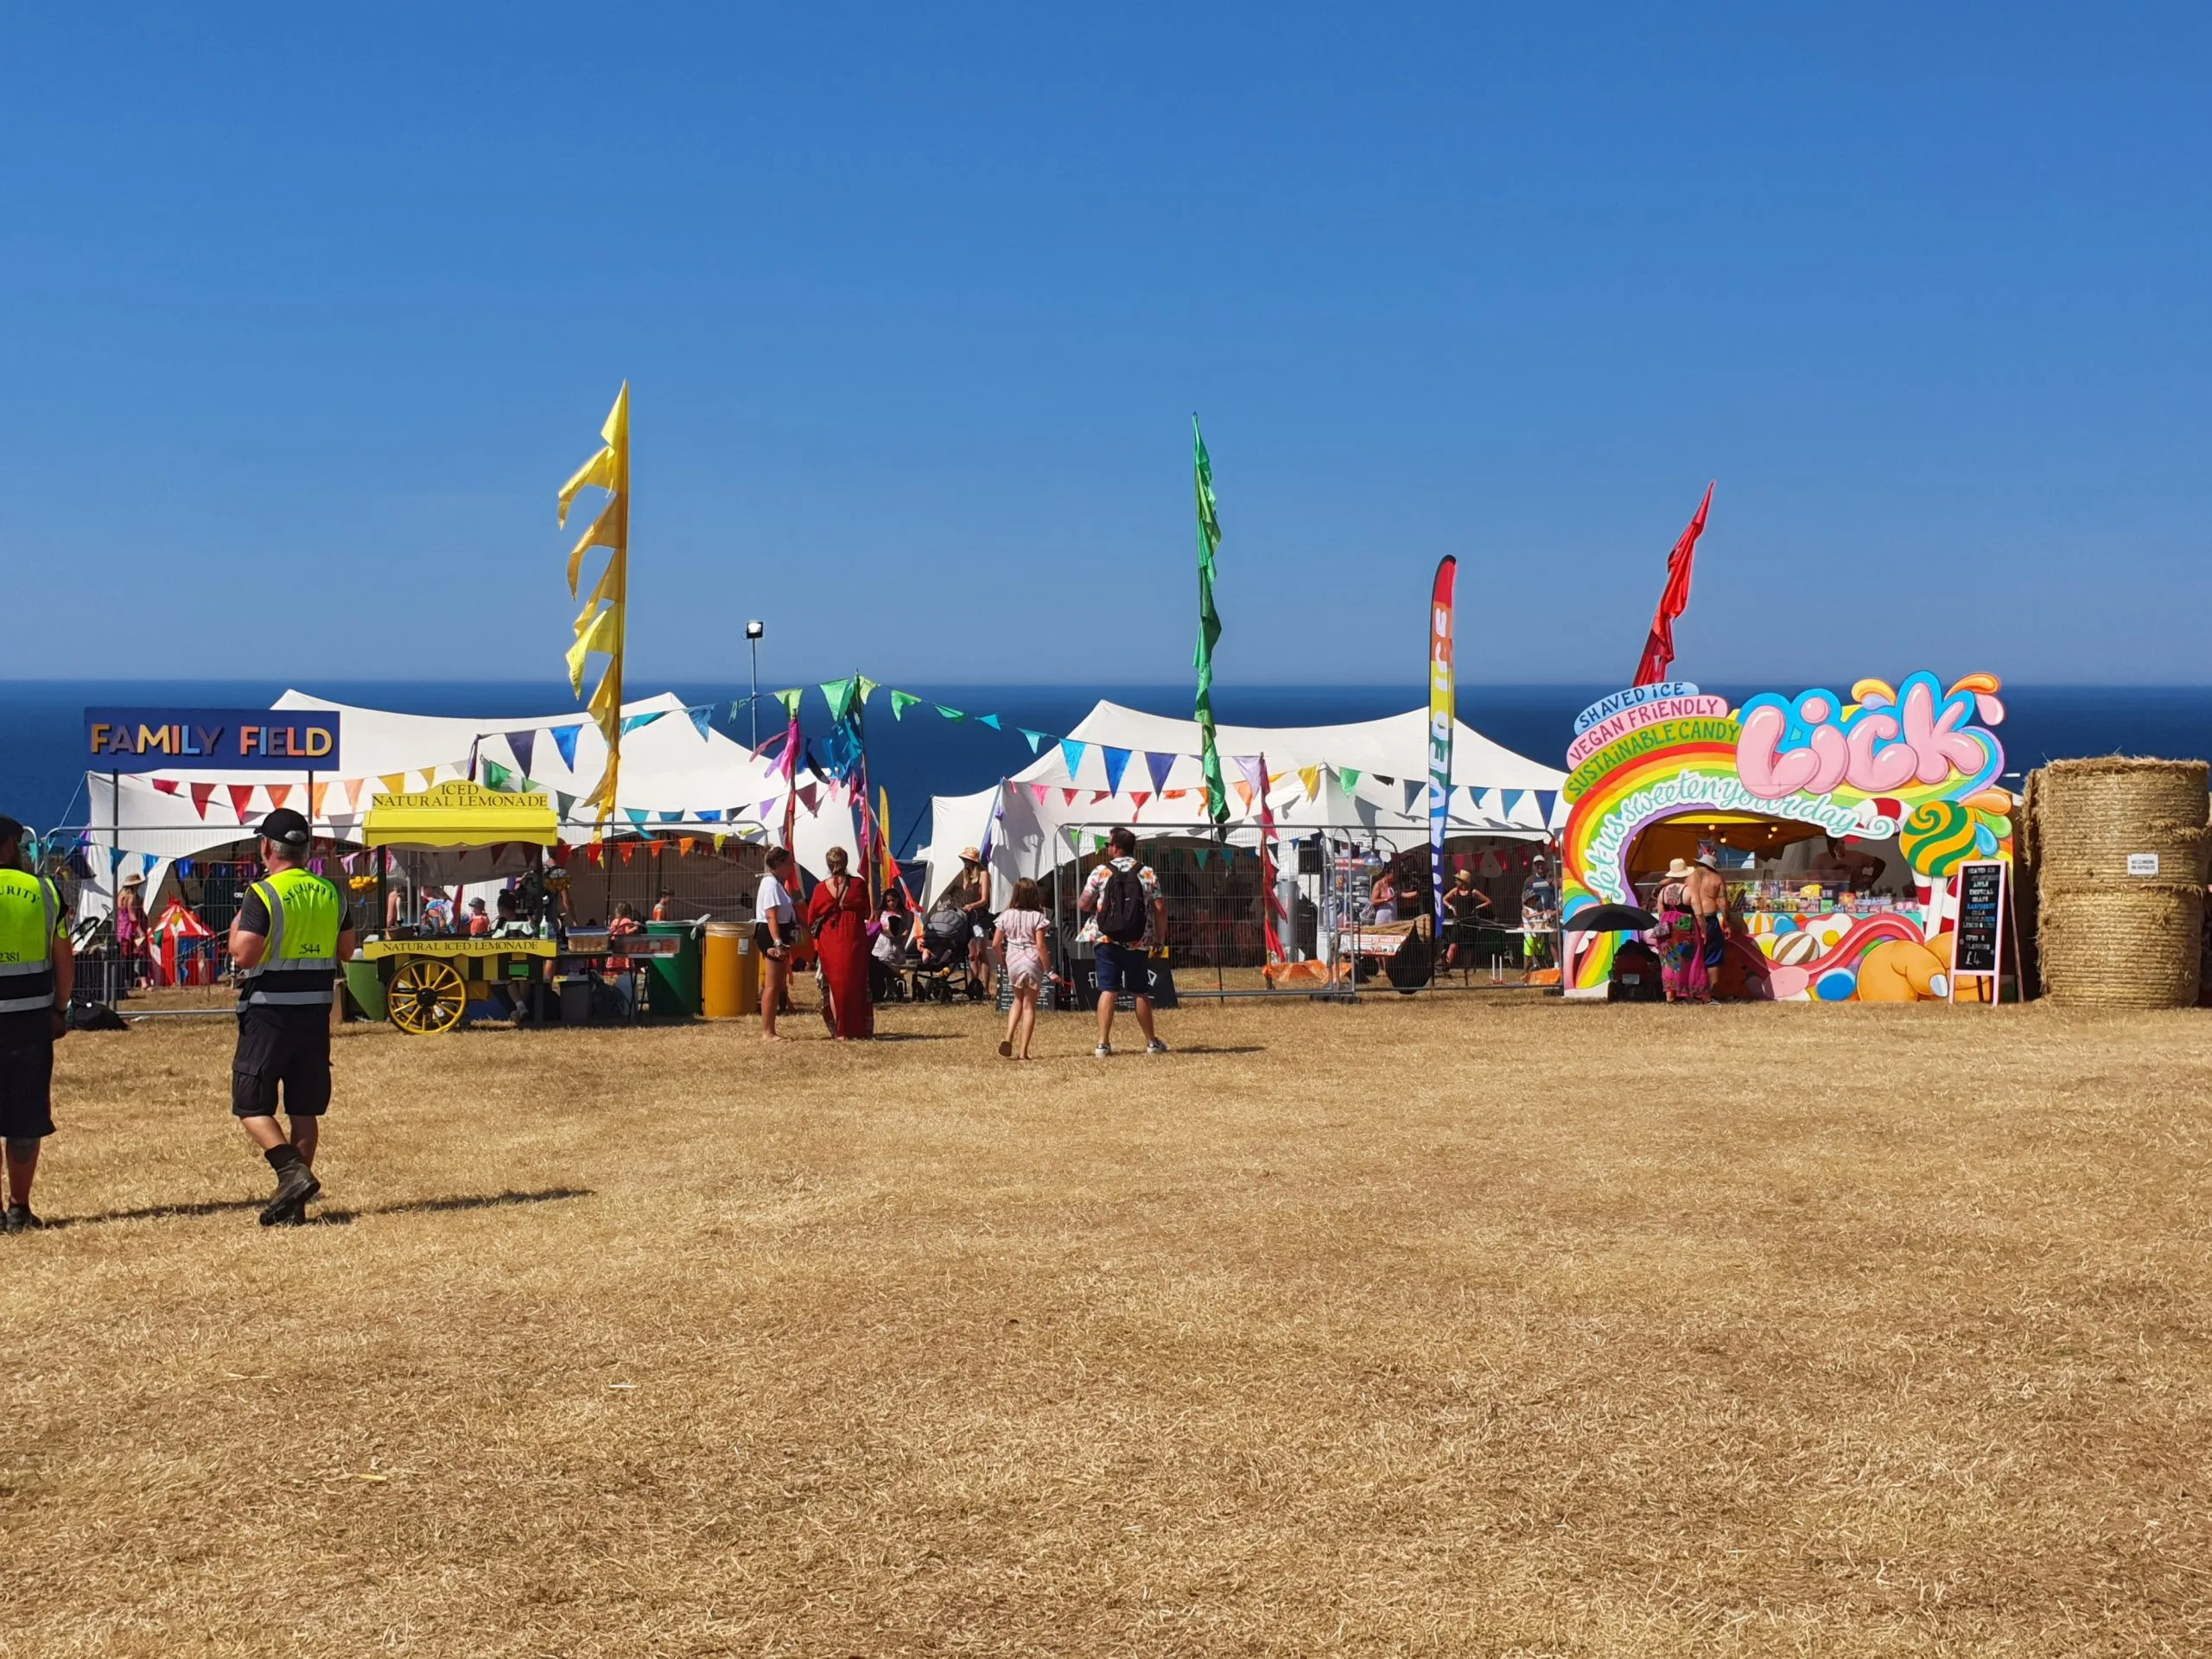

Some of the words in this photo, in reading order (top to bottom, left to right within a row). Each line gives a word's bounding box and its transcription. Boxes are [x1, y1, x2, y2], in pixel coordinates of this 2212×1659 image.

[1580, 688, 1645, 728] SHAVED
[91, 724, 224, 755] FAMILY
[240, 726, 334, 756] FIELD
[1569, 717, 1624, 761] VEGAN
[1679, 721, 1739, 742] CANDY
[1736, 682, 1985, 799] Lick
[442, 785, 479, 795] ICED
[372, 796, 454, 807] NATURAL
[460, 796, 548, 806] LEMONADE
[1625, 772, 1719, 822] sweeten
[1800, 794, 1890, 836] day
[0, 885, 40, 904] URITY
[283, 882, 336, 904] SECURITY
[383, 941, 442, 951] NATURAL
[444, 941, 471, 950] ICED
[475, 941, 538, 950] LEMONADE
